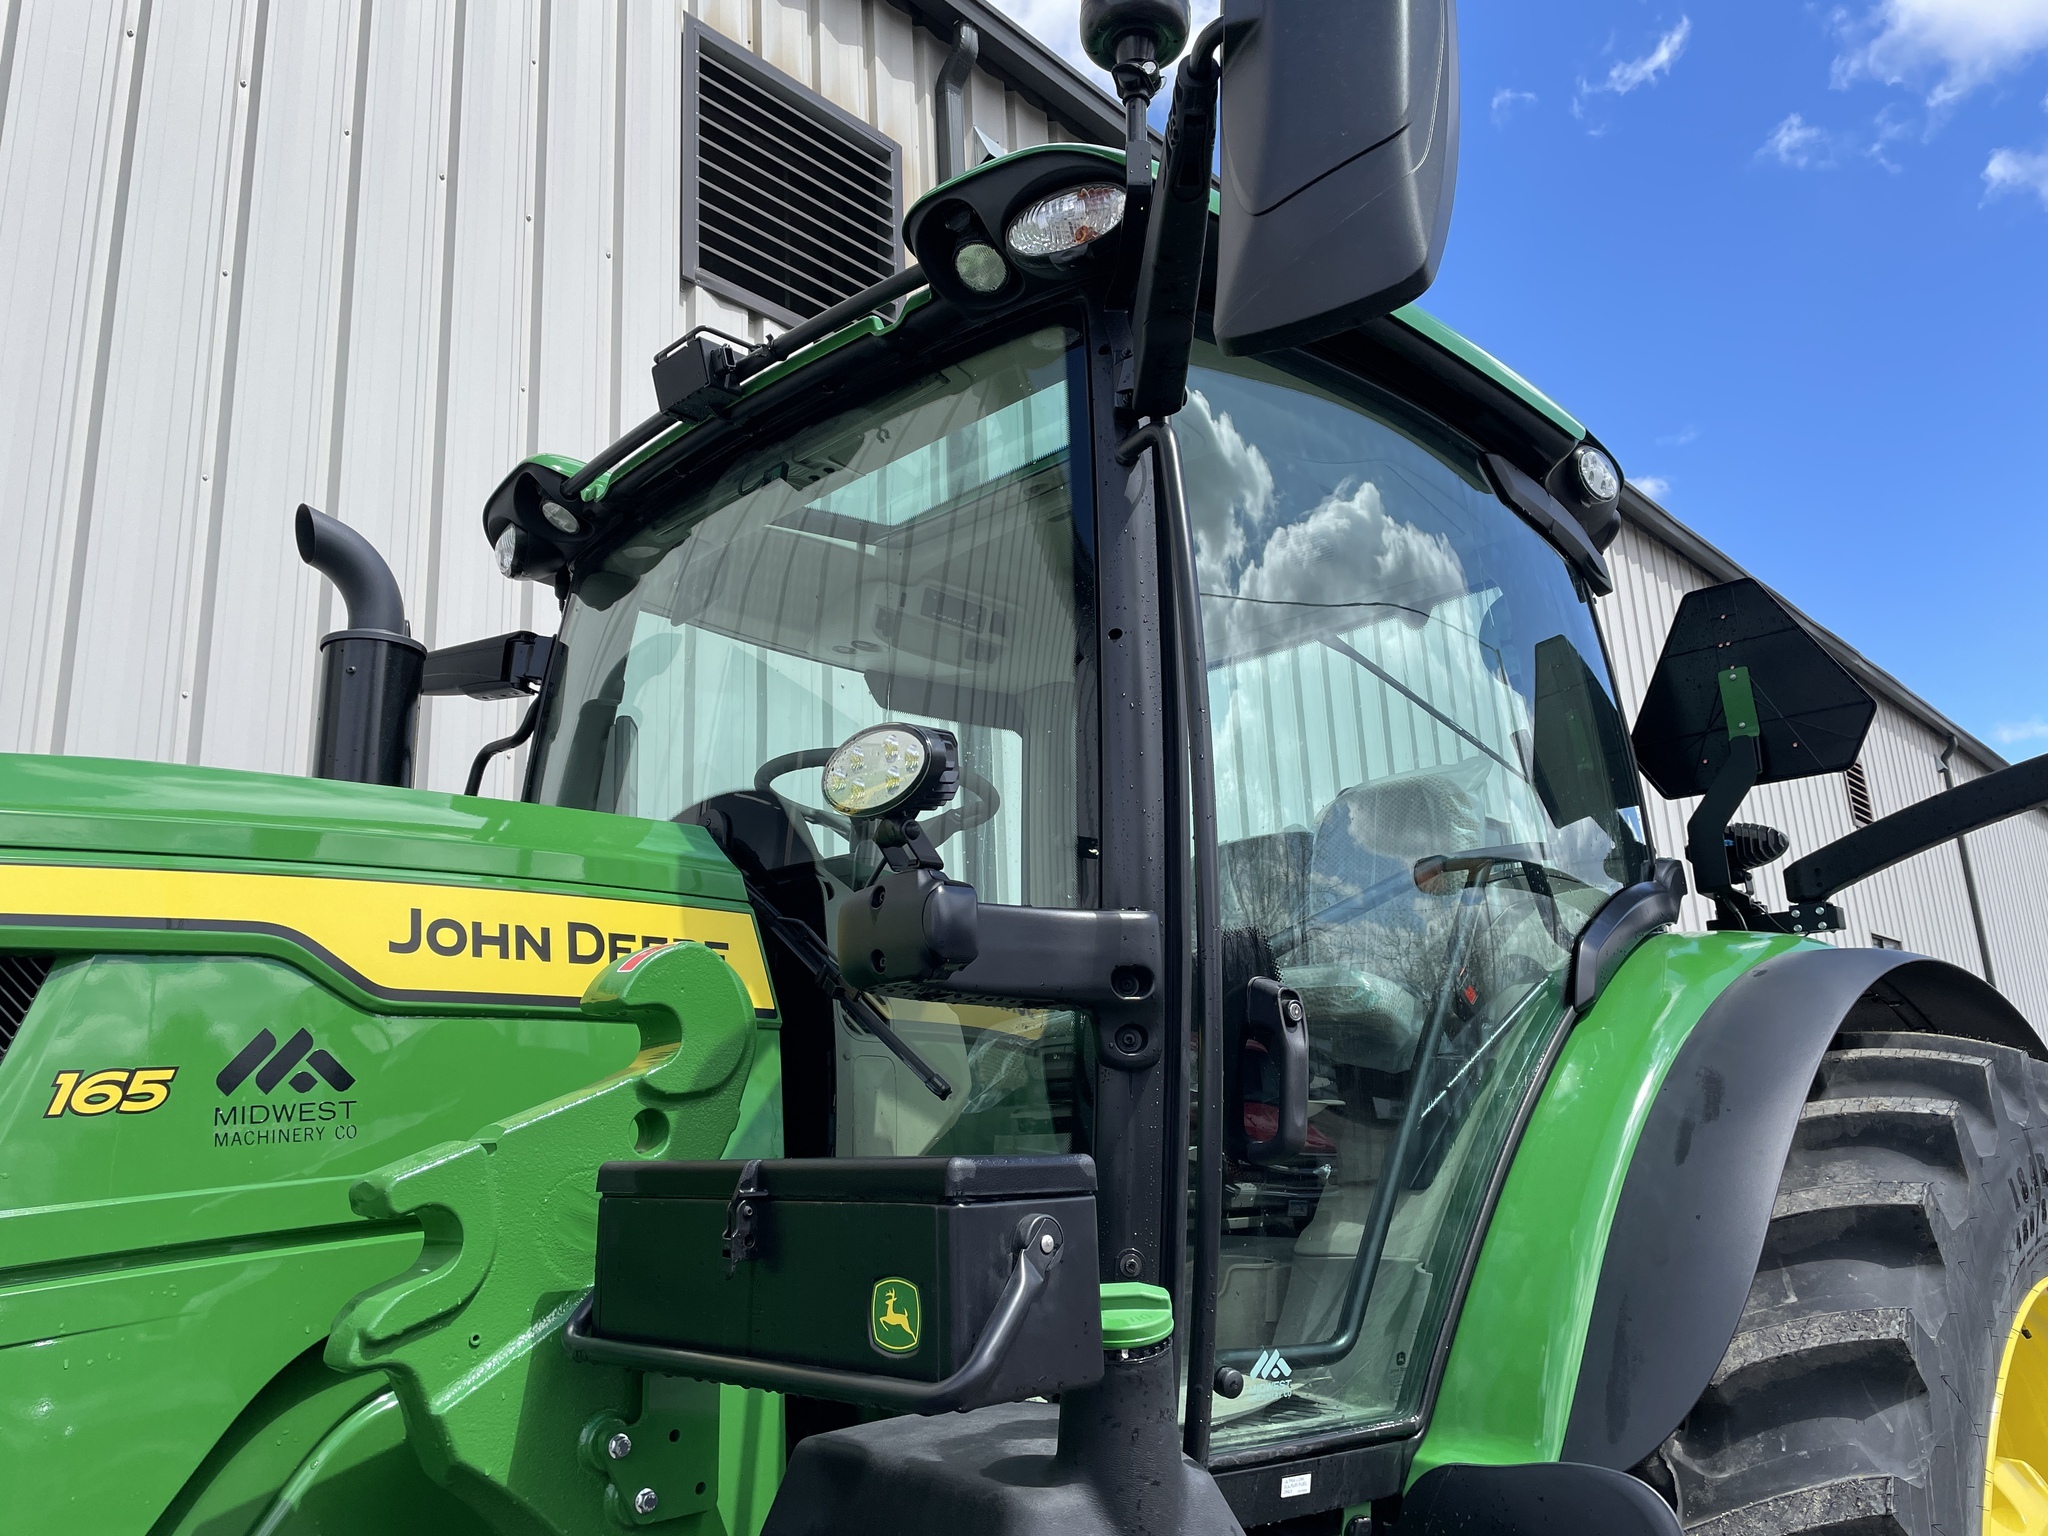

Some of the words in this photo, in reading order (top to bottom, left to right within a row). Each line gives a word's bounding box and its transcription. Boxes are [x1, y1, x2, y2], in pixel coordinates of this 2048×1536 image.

[388, 907, 551, 963] JOHN
[43, 1066, 180, 1119] 165
[214, 1100, 357, 1127] MIDWEST
[213, 1126, 326, 1147] MACHINERY
[334, 1124, 357, 1140] CO
